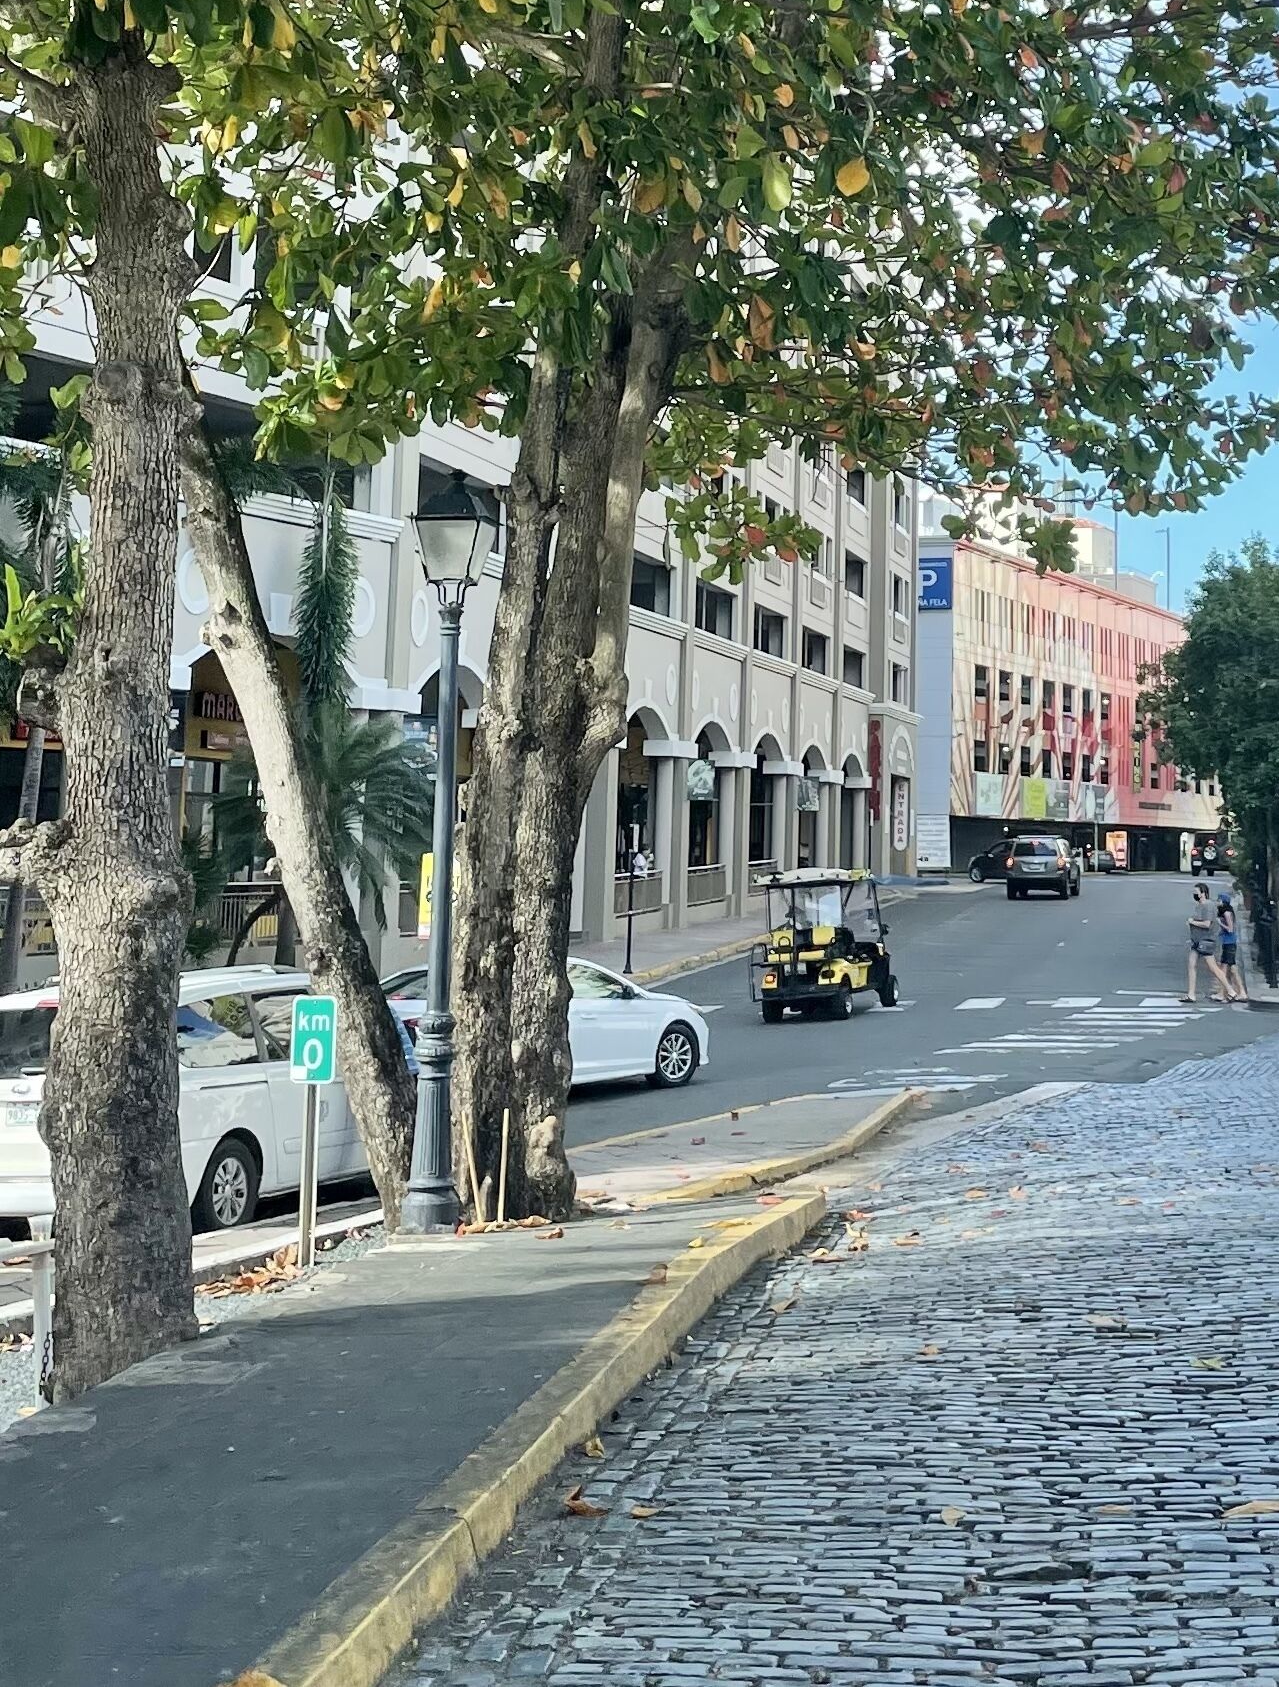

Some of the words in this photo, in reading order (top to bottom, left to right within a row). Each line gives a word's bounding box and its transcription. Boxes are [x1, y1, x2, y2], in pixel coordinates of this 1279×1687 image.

[918, 569, 938, 597] P
[897, 783, 905, 844] ENTRADA
[298, 1010, 331, 1031] km
[302, 1038, 324, 1070] 0
